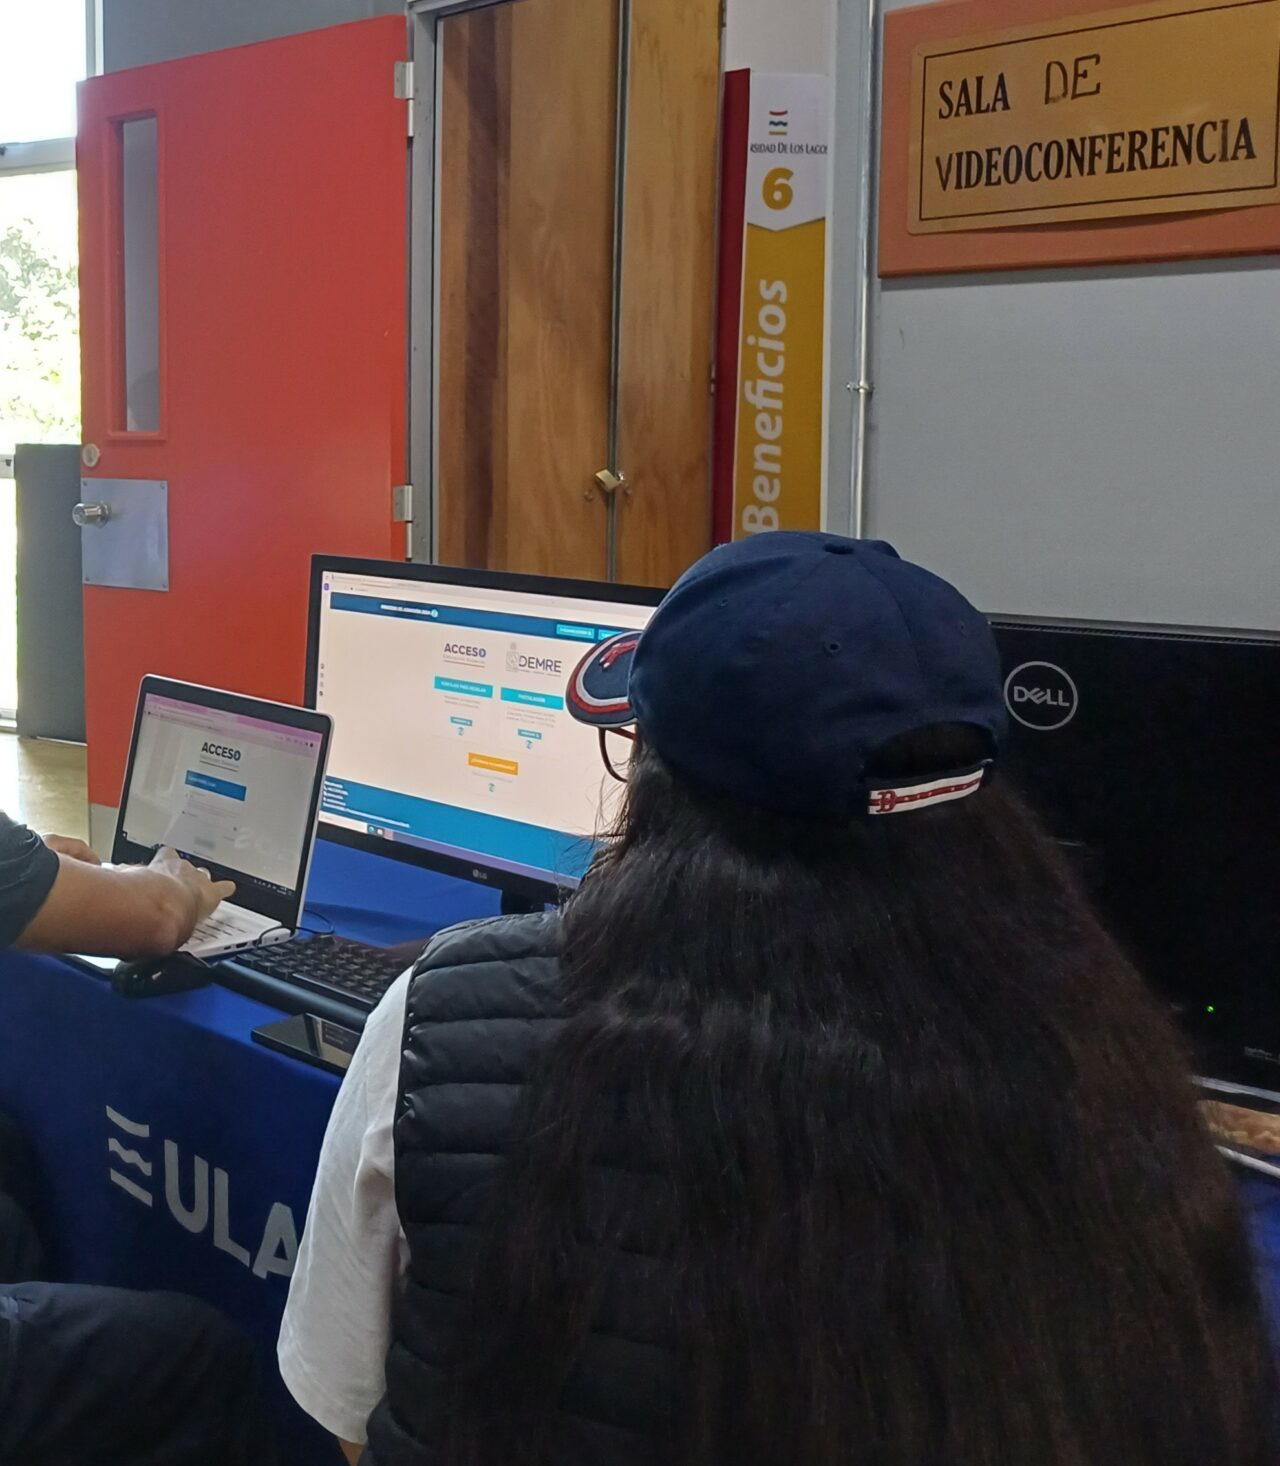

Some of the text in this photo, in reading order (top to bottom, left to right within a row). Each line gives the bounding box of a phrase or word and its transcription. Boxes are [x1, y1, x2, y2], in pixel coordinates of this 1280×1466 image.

[938, 53, 1101, 120] SALA DE
[935, 117, 1257, 192] VIDEOCONFERENCIA
[761, 167, 794, 211] 6
[742, 278, 788, 535] Beneficios
[444, 642, 487, 658] ACCESO
[518, 655, 562, 673] DEMRE
[1013, 685, 1070, 707] DELL
[201, 741, 241, 761] ACCESO
[164, 1138, 299, 1281] ULA
